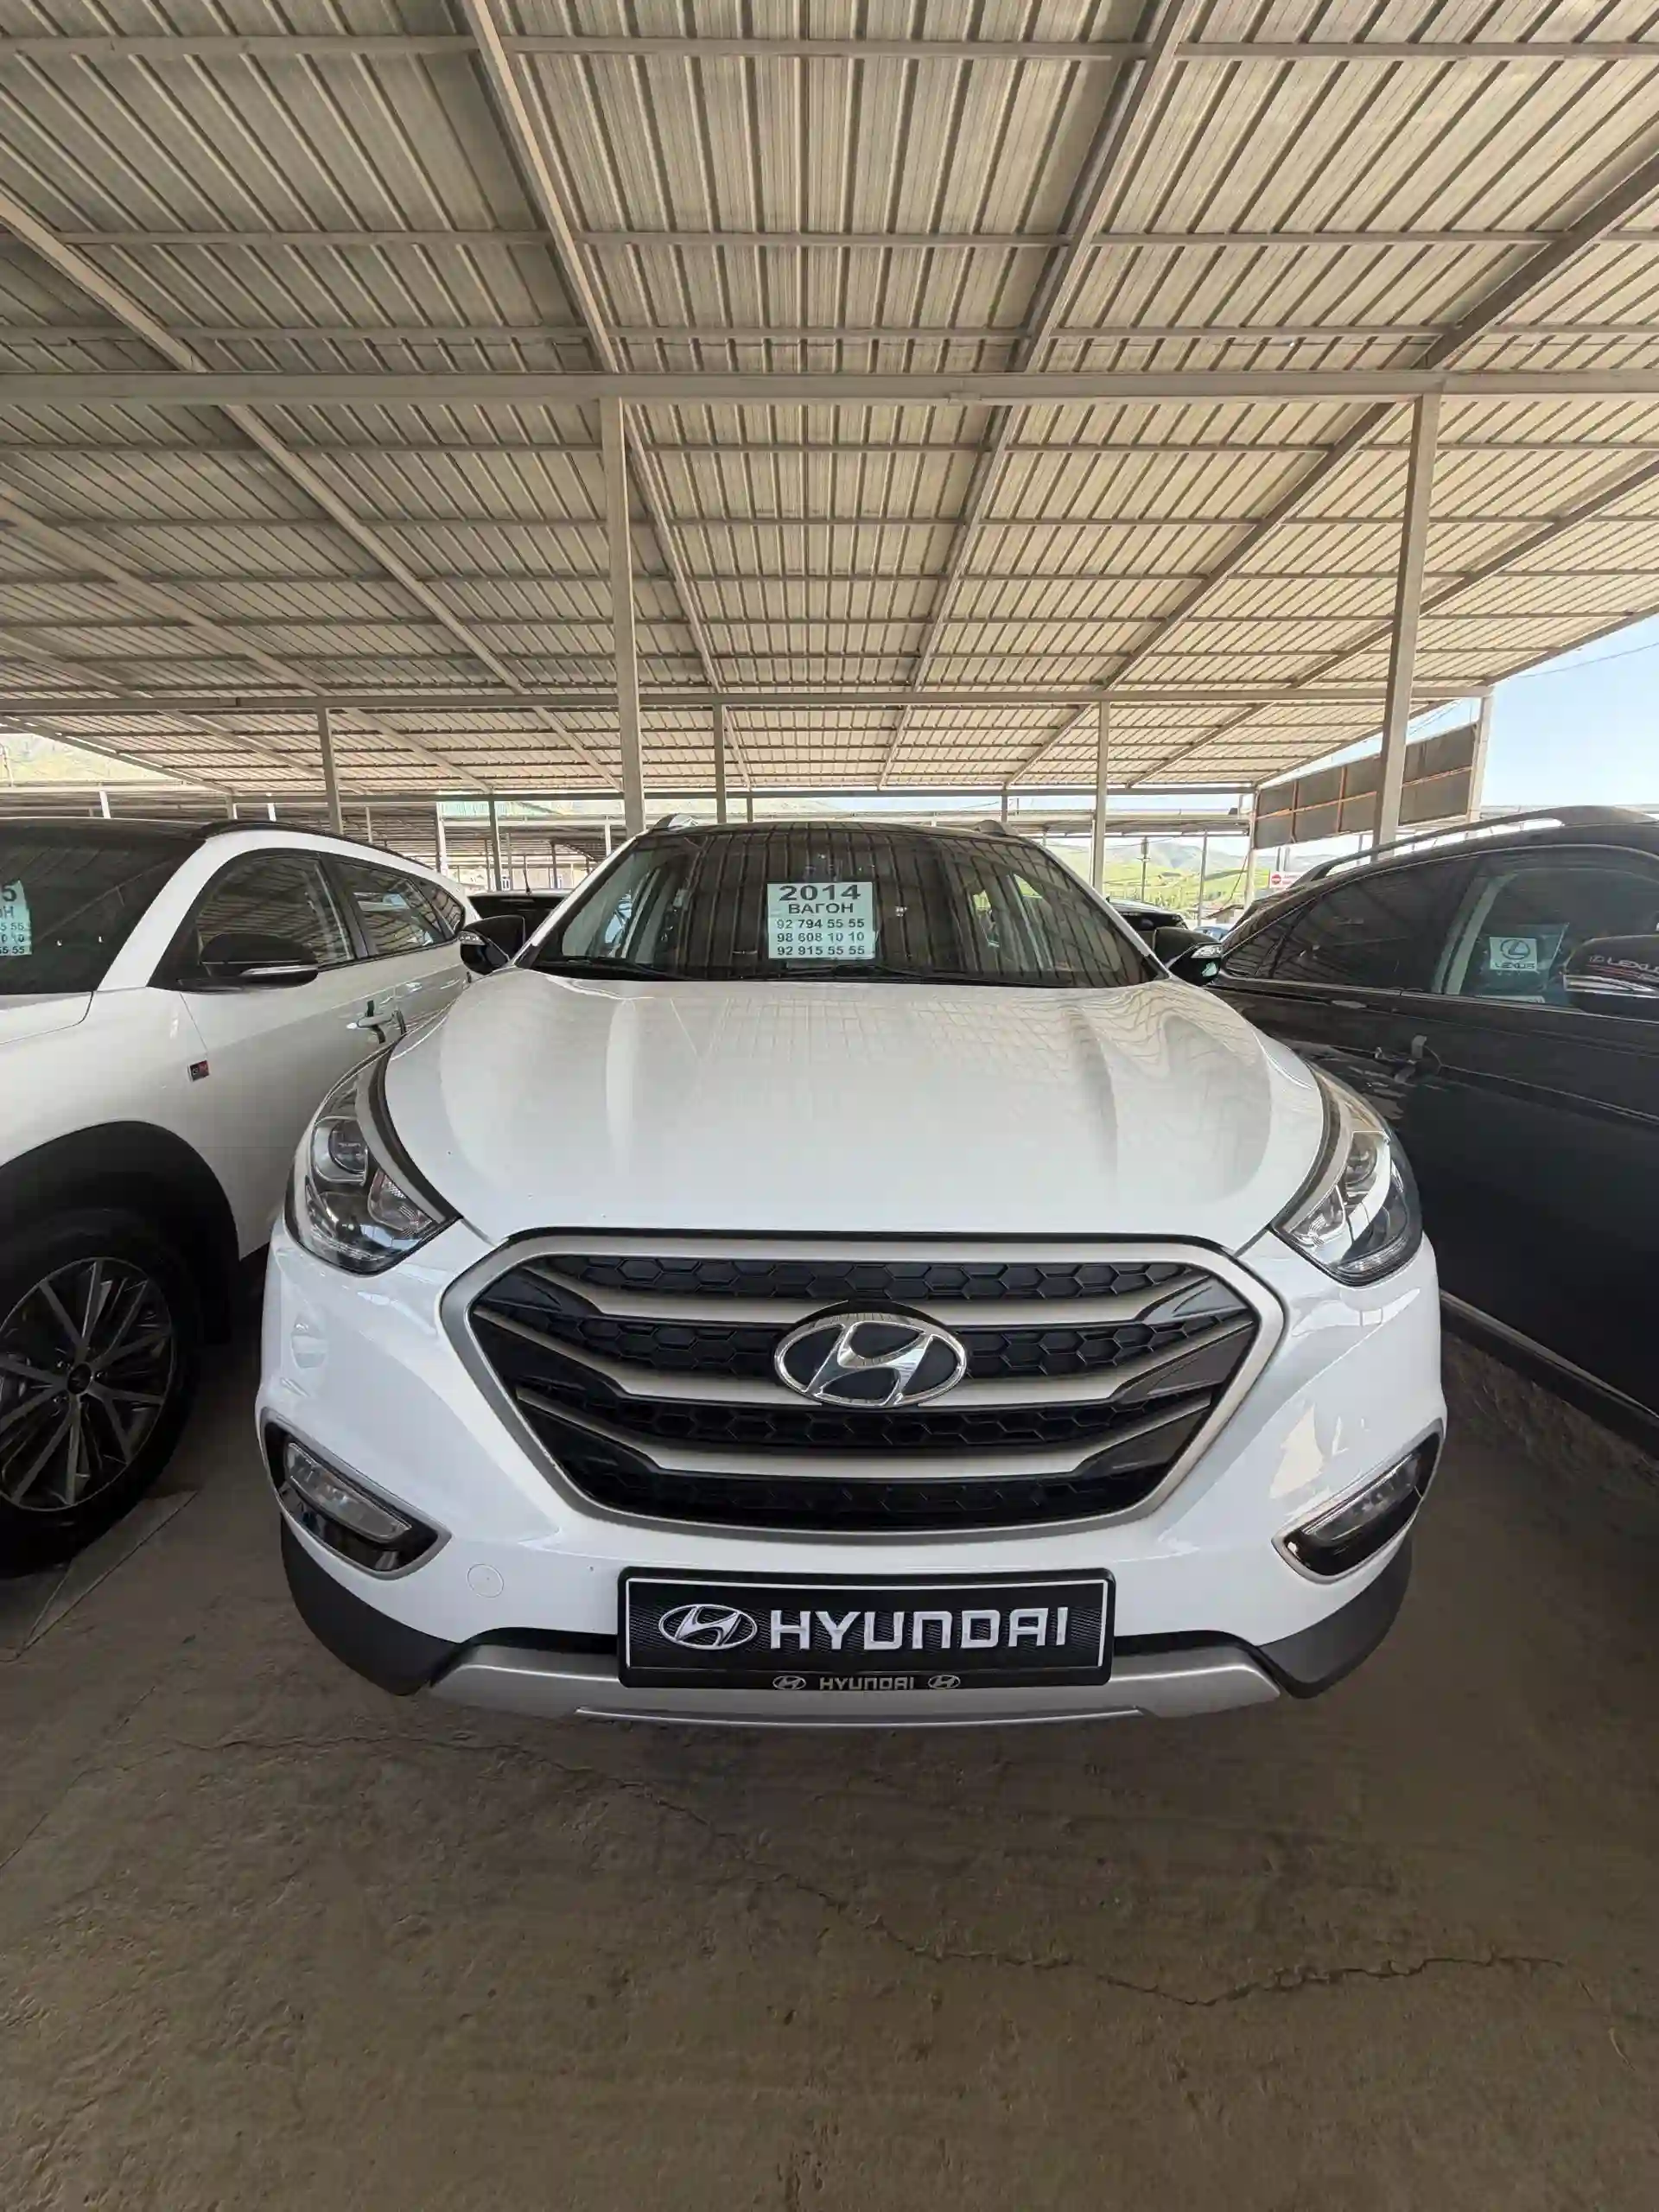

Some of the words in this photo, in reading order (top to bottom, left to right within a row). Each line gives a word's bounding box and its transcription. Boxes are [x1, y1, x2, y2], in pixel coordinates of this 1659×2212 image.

[779, 884, 861, 901] 2014
[788, 903, 854, 914] ВАГОН
[777, 919, 792, 929] 92
[798, 918, 823, 929] 794
[827, 918, 843, 928] 55
[849, 918, 865, 928] 55
[777, 933, 793, 942] 98
[798, 932, 823, 943] 608
[827, 932, 843, 942] 10
[849, 931, 864, 942] 10
[778, 946, 793, 955] 92
[798, 946, 823, 955] 915
[828, 946, 843, 955] 55
[849, 945, 865, 955] 55
[771, 1606, 1068, 1649] HYUNDAI
[819, 1676, 914, 1690] HYUNDAI
